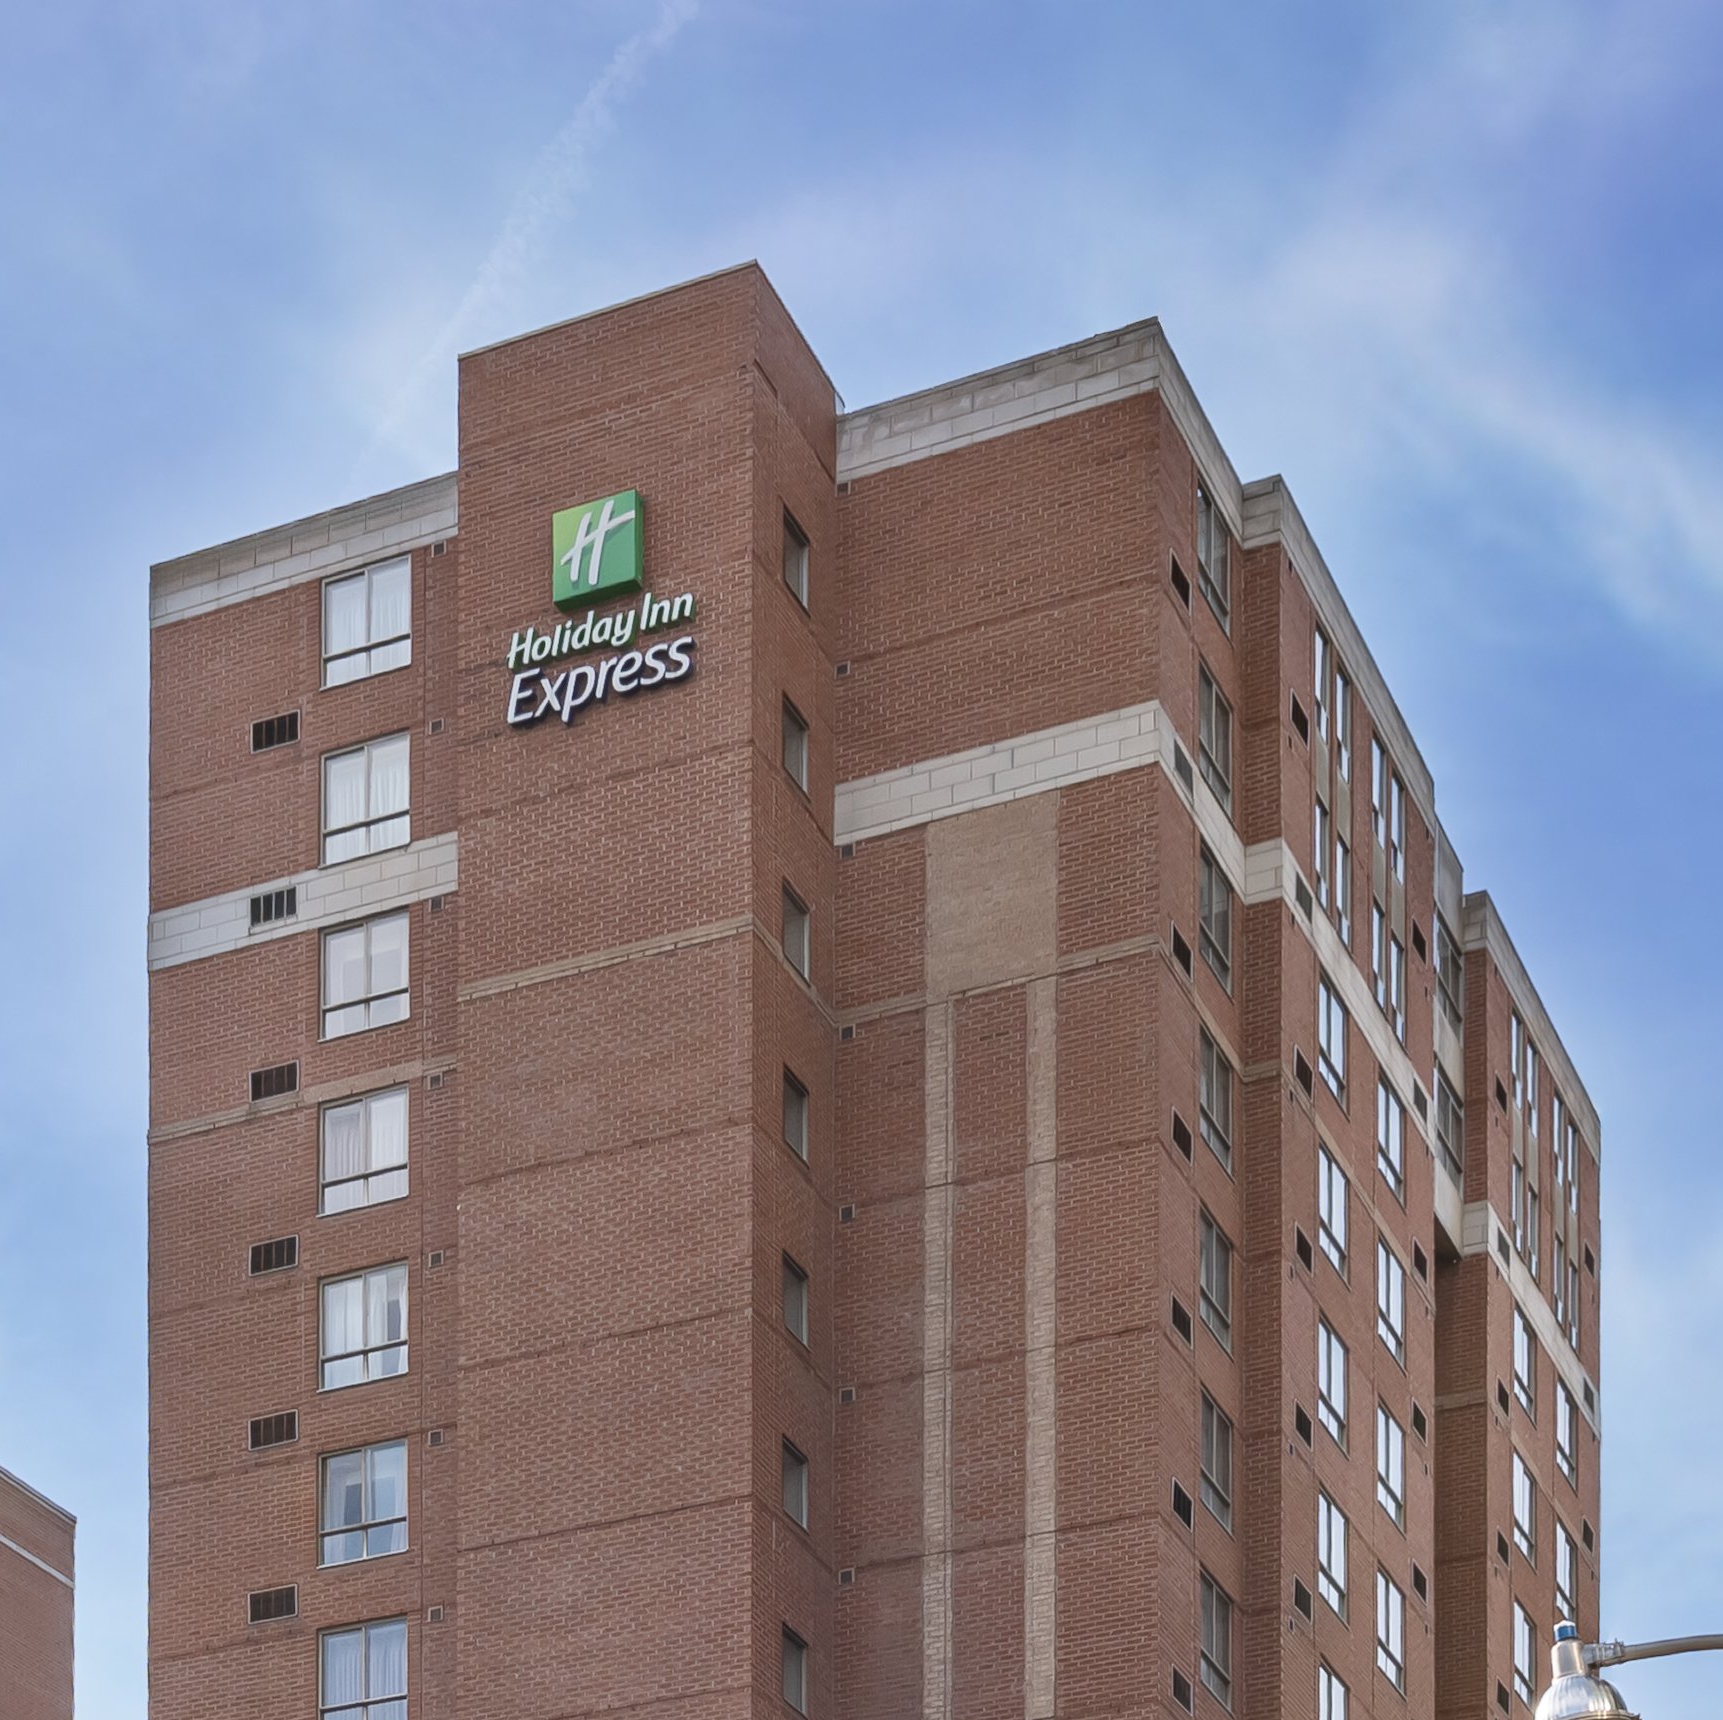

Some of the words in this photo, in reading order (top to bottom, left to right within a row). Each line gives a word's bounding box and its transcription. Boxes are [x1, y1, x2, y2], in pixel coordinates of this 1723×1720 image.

[506, 610, 636, 669] Holiday
[640, 592, 694, 630] Inn
[507, 636, 693, 724] Express
